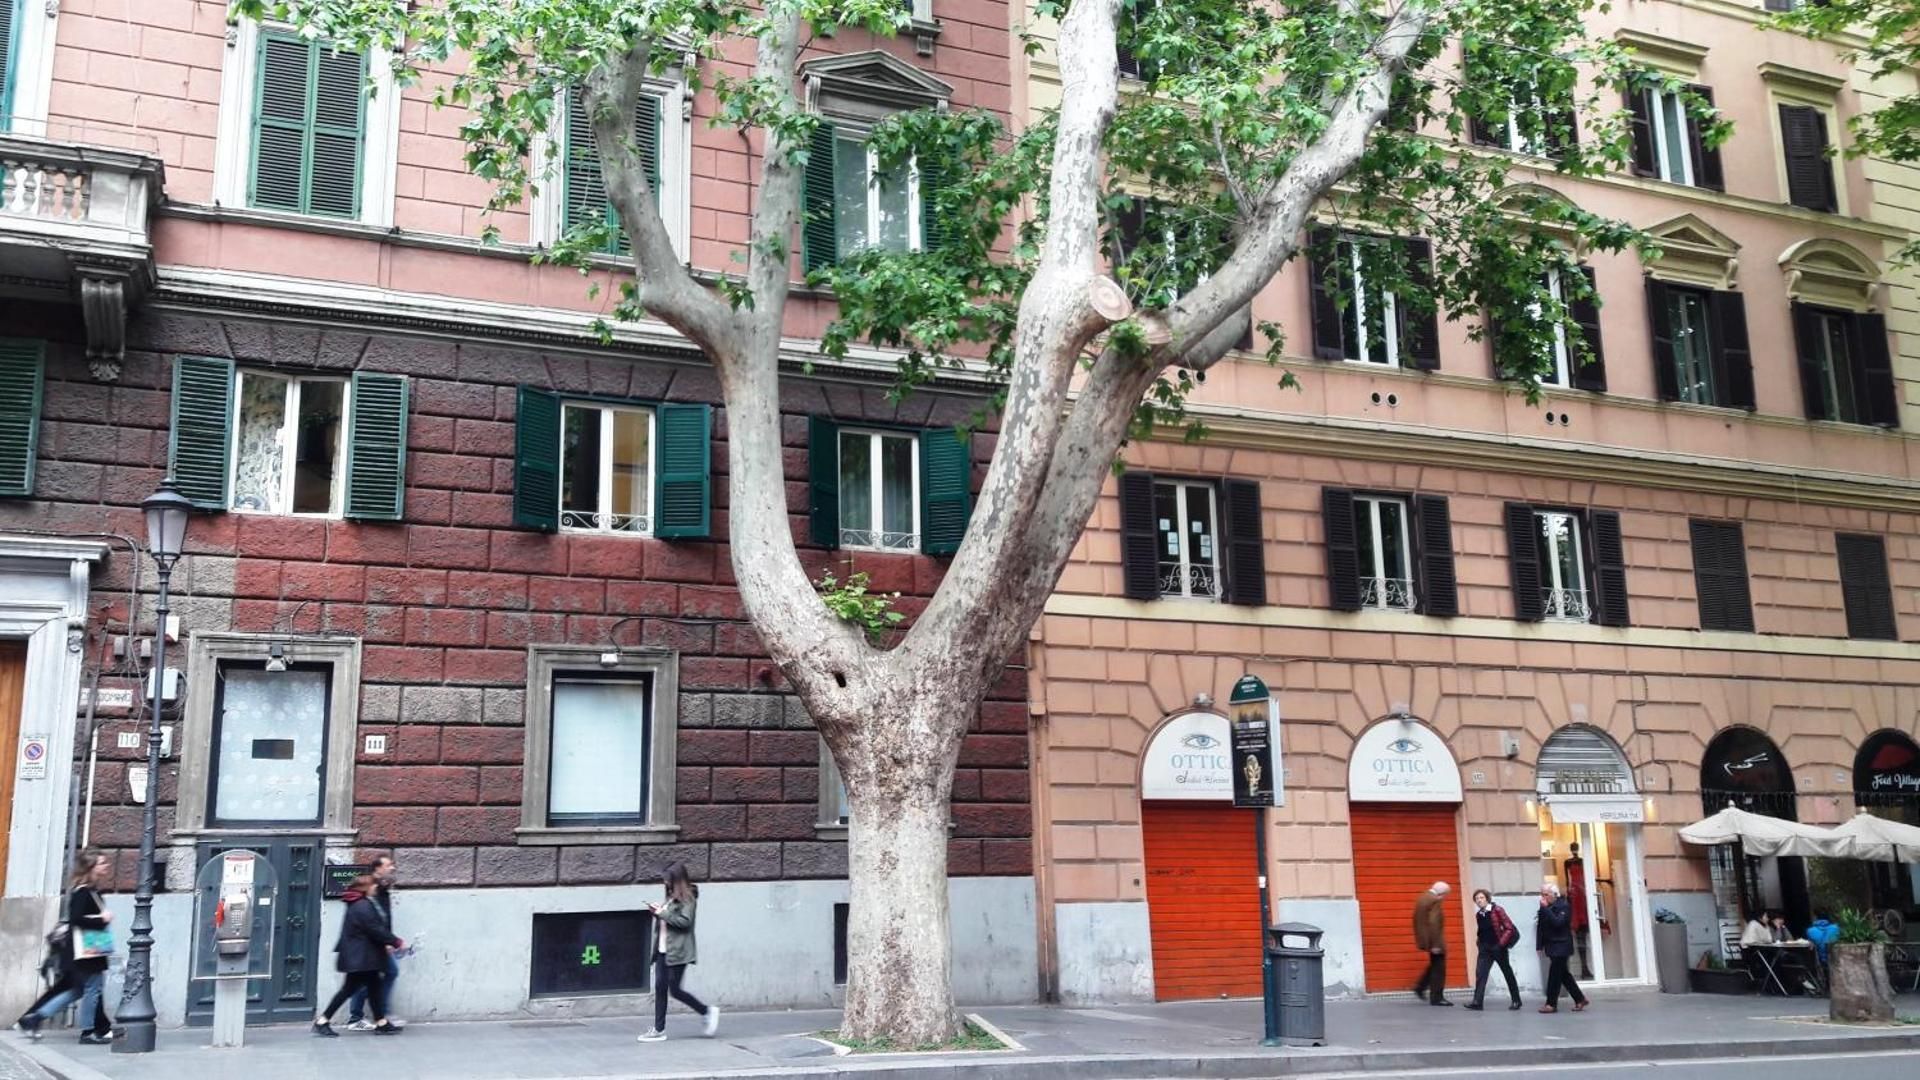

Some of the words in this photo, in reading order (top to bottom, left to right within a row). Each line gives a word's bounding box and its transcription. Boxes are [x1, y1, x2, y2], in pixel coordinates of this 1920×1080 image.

[120, 733, 139, 746] 110
[367, 740, 382, 750] 111
[1170, 754, 1232, 770] OTTIC
[1372, 758, 1434, 773] OTTICA
